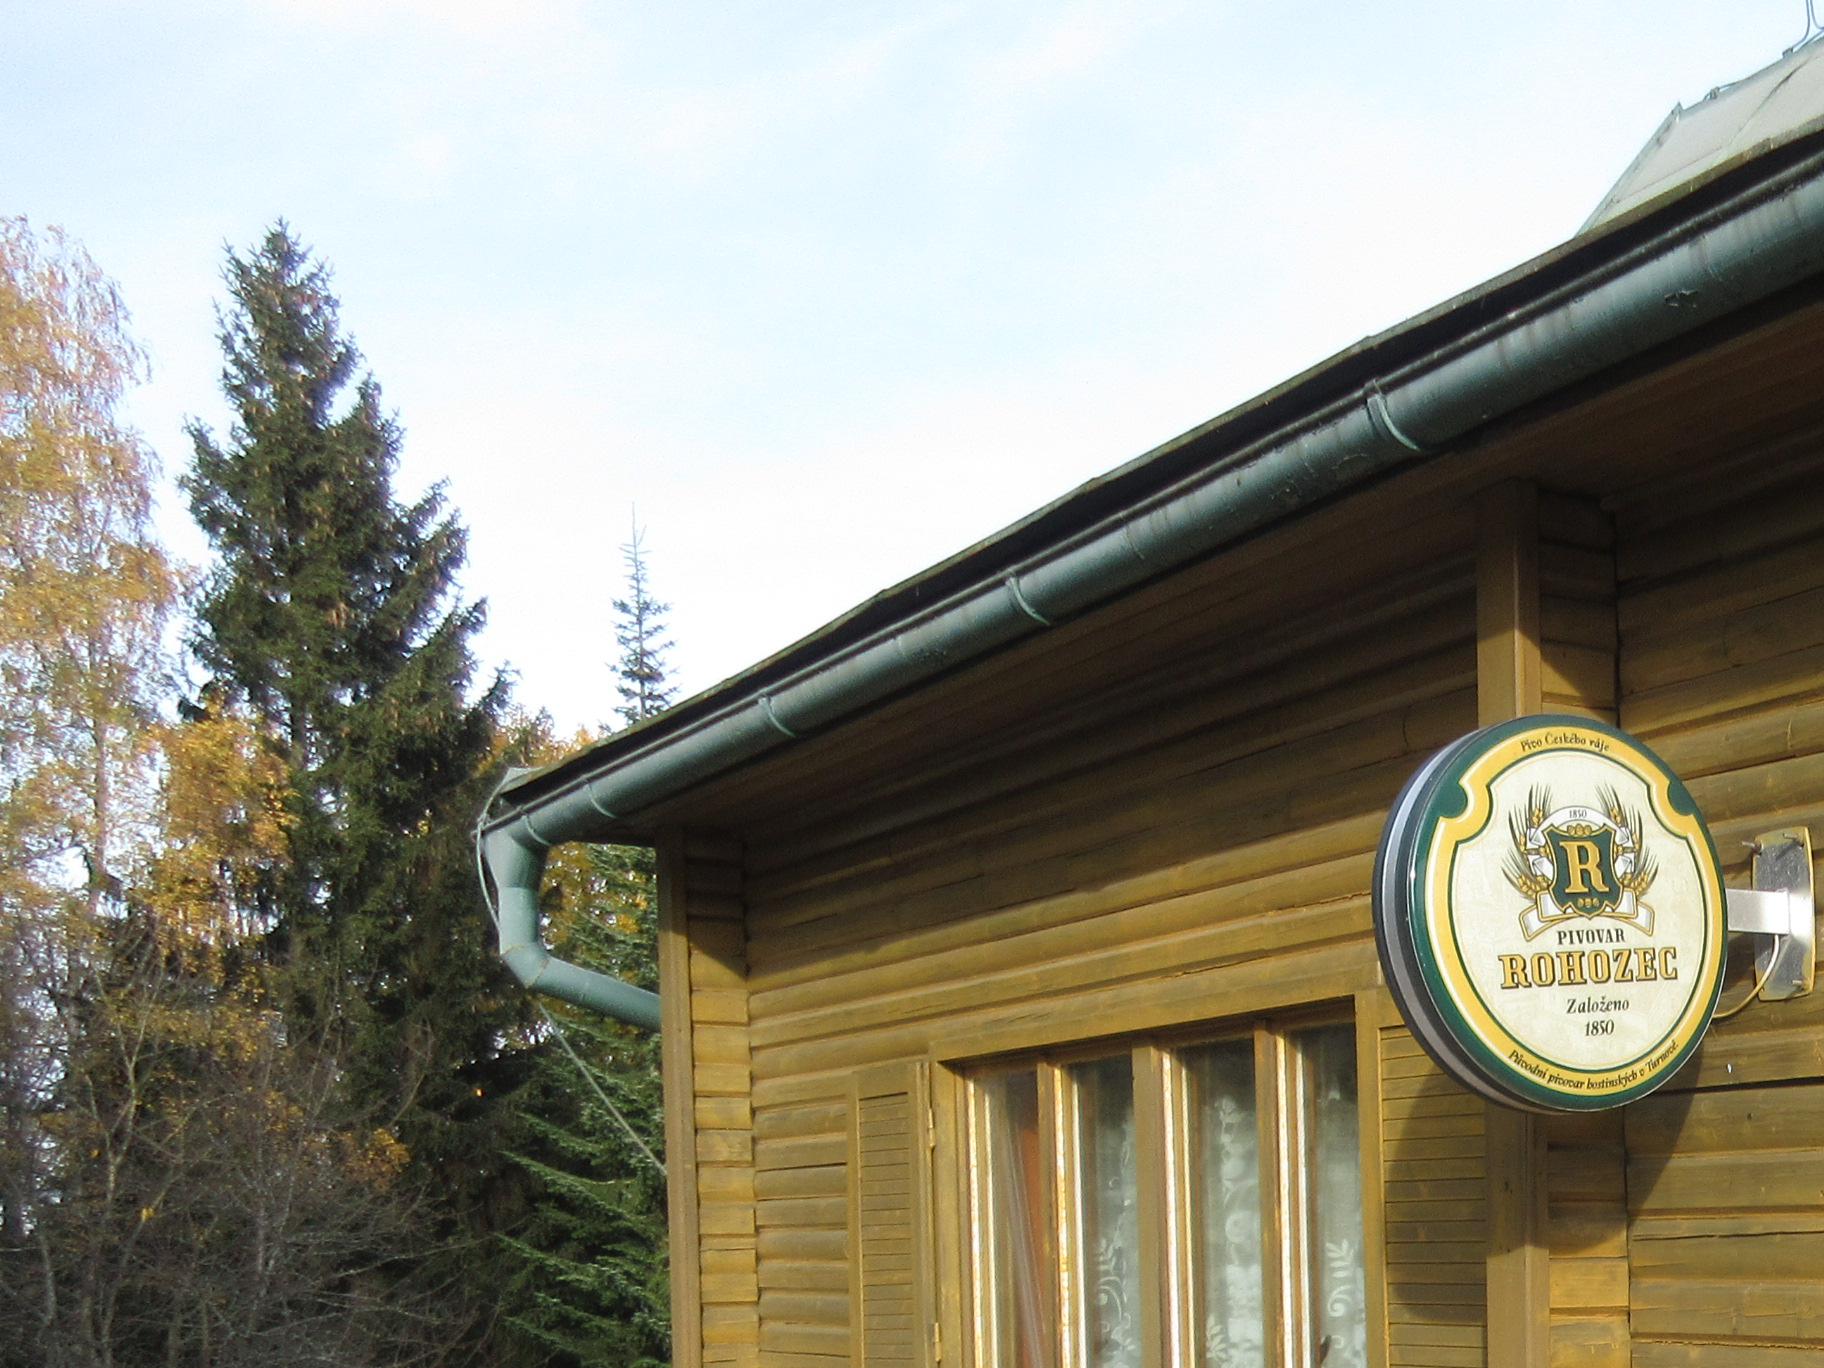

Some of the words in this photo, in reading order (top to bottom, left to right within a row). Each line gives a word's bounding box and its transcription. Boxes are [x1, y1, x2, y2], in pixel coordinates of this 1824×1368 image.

[1521, 739, 1542, 752] Pivo
[1545, 731, 1586, 745] Českého
[1589, 738, 1610, 753] ráje
[1569, 809, 1587, 819] 1850
[1559, 840, 1609, 894] R
[1557, 928, 1625, 945] PIVOVAR
[1498, 947, 1678, 989] ROHOZEC
[1566, 996, 1630, 1014] Založeno
[1584, 1020, 1615, 1037] 1850
[1508, 1049, 1549, 1080] Původní
[1547, 1073, 1585, 1089] pivovar
[1586, 1071, 1637, 1090] hostinských
[1639, 1069, 1645, 1077] v
